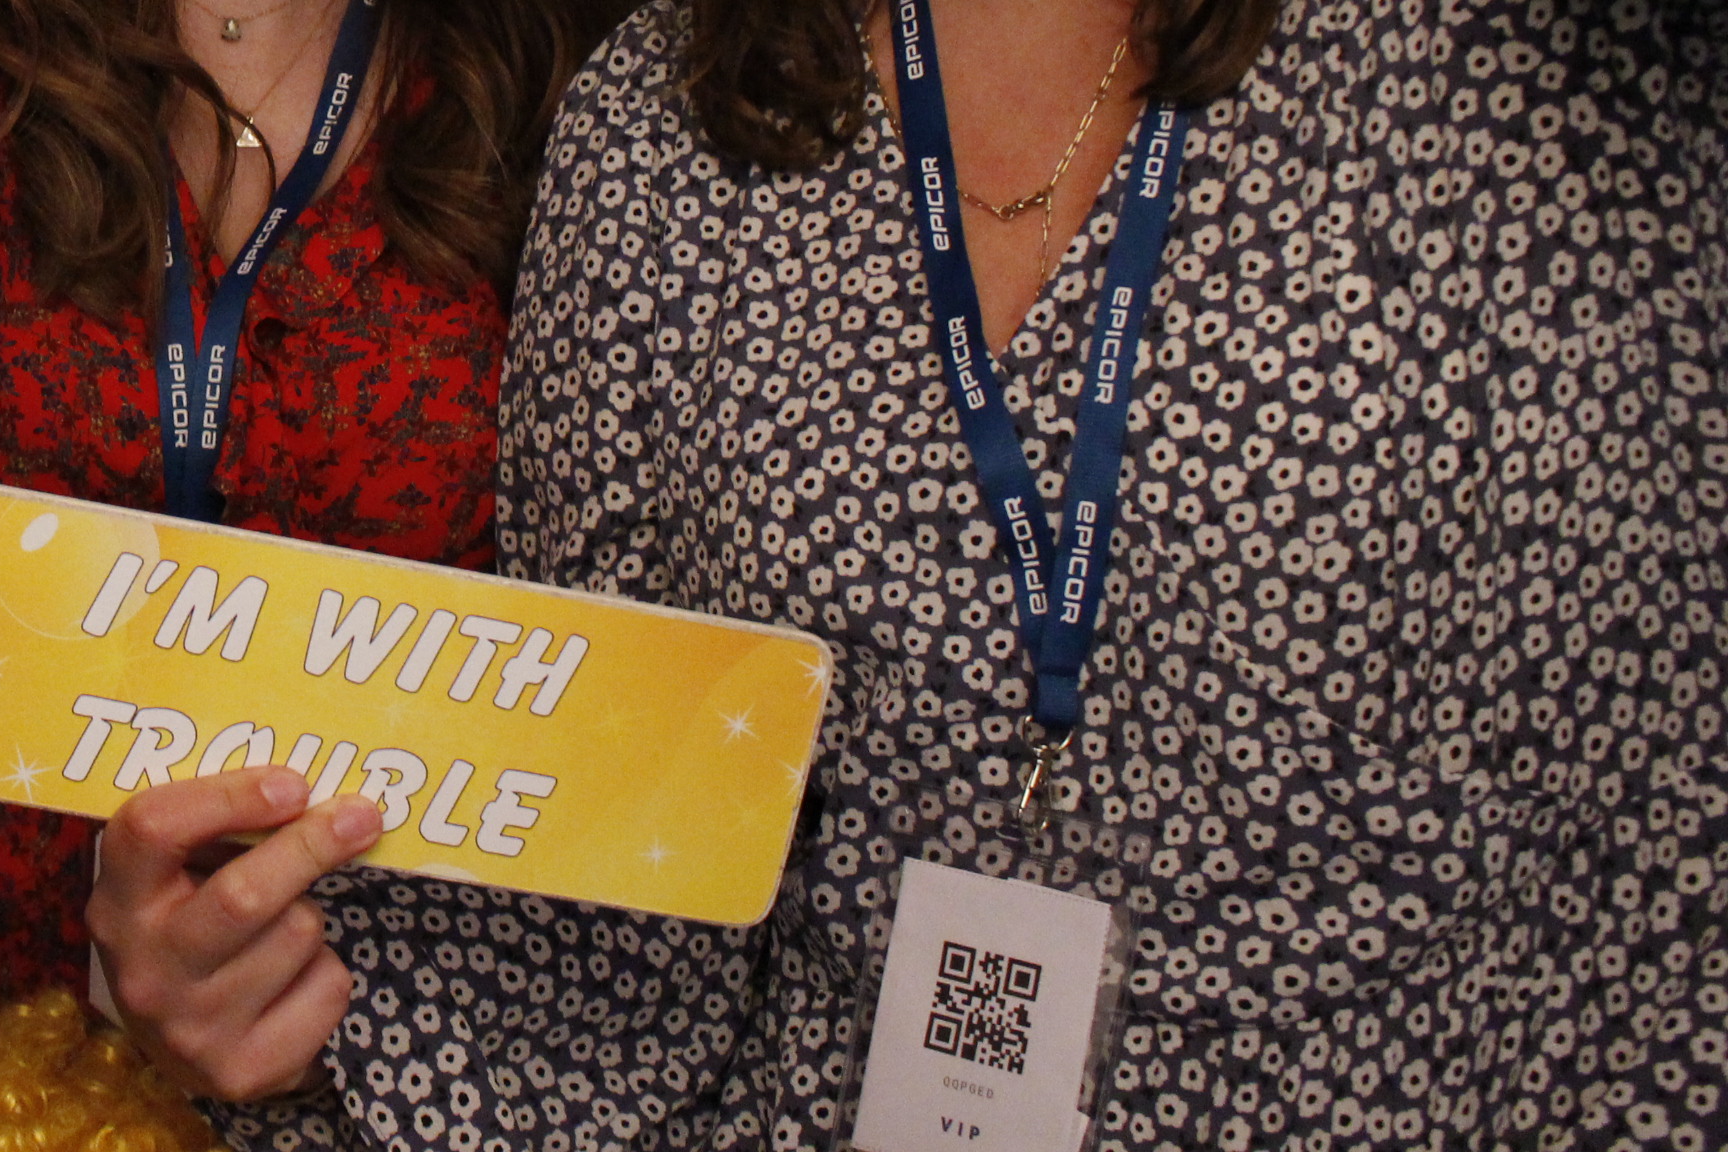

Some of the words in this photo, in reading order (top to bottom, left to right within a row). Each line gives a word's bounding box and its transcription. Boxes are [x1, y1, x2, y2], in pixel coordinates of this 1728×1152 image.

[1139, 103, 1173, 199] PICOR
[81, 551, 270, 663] I'M
[302, 588, 590, 717] WITH
[941, 1116, 980, 1140] VIP
